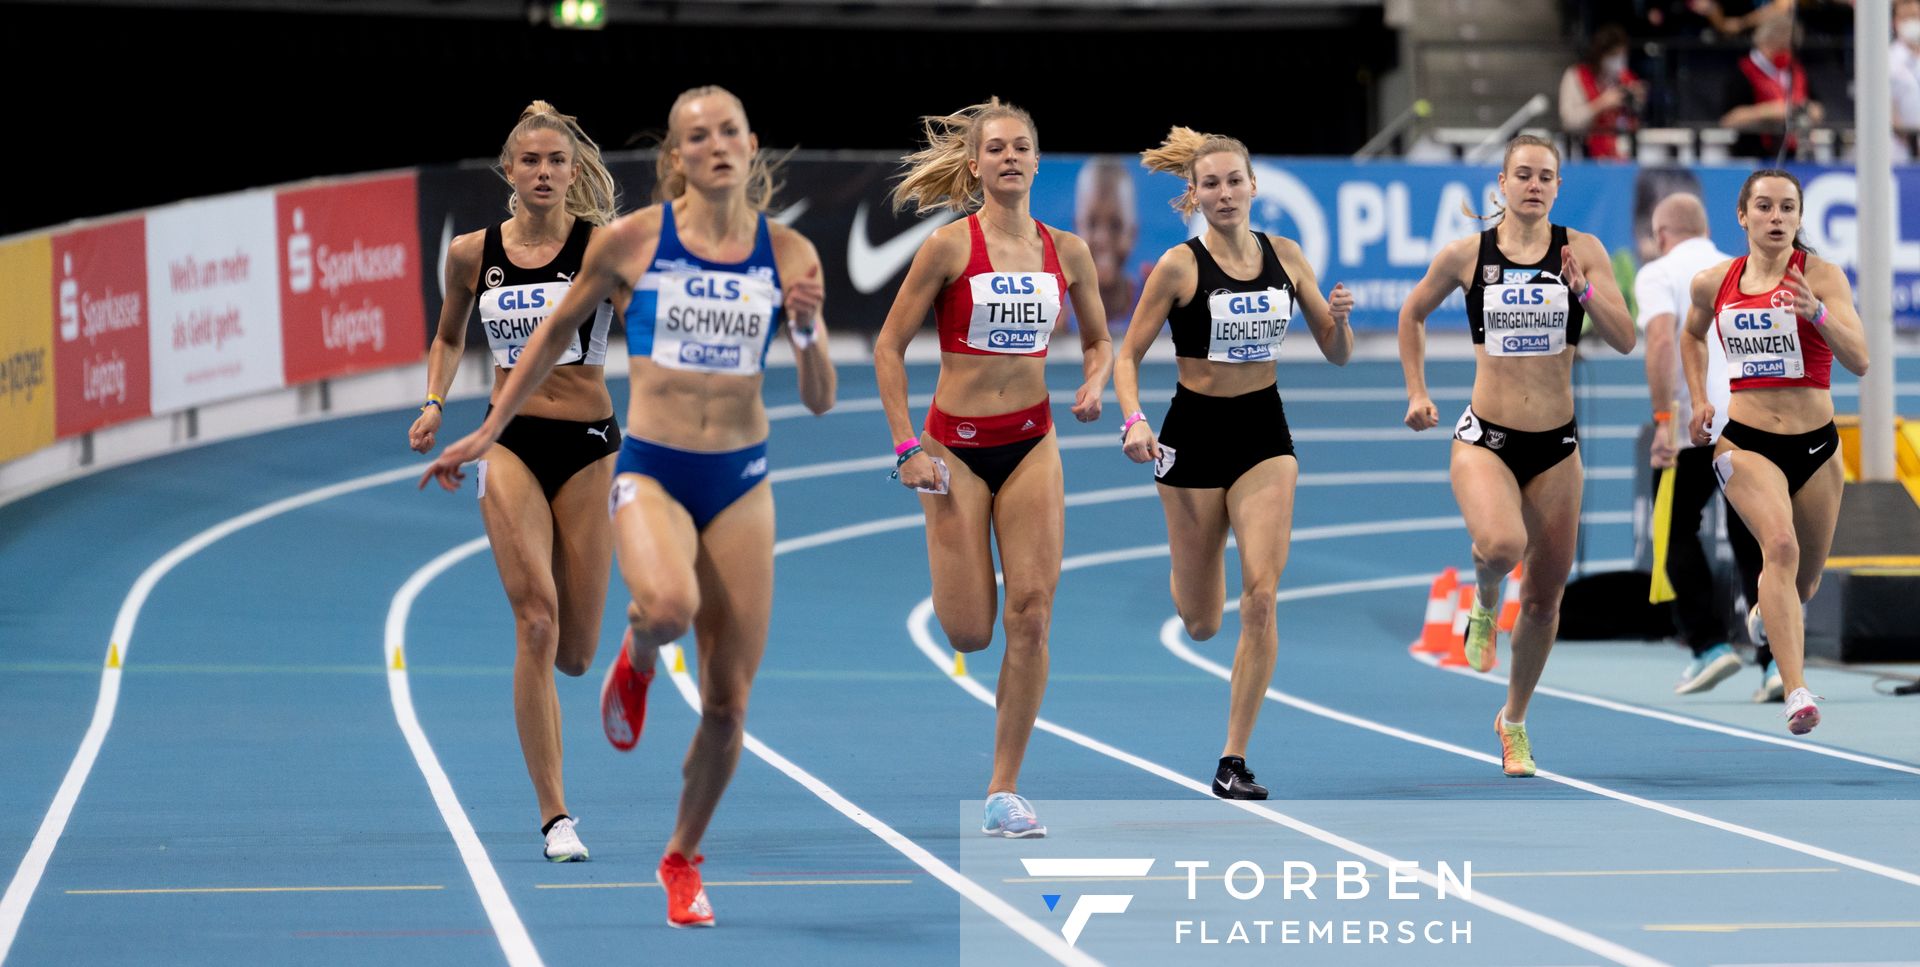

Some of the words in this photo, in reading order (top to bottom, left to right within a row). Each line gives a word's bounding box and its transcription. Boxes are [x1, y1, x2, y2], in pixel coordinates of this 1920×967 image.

[316, 238, 406, 296] Sparkasse
[81, 285, 140, 345] Sparkasse
[666, 305, 761, 338] SCHWAB
[987, 303, 1047, 323] THIEL
[1488, 312, 1564, 330] MERGENTHALER
[321, 299, 385, 353] Leipzig
[488, 316, 549, 340] SCHM
[1216, 319, 1287, 341] LECHLEITNER
[1010, 333, 1035, 342] PLAN
[1522, 338, 1548, 346] PLAN
[1727, 334, 1795, 354] FRANZEN
[1757, 362, 1783, 372] PLAN
[83, 351, 125, 406] Leipzig
